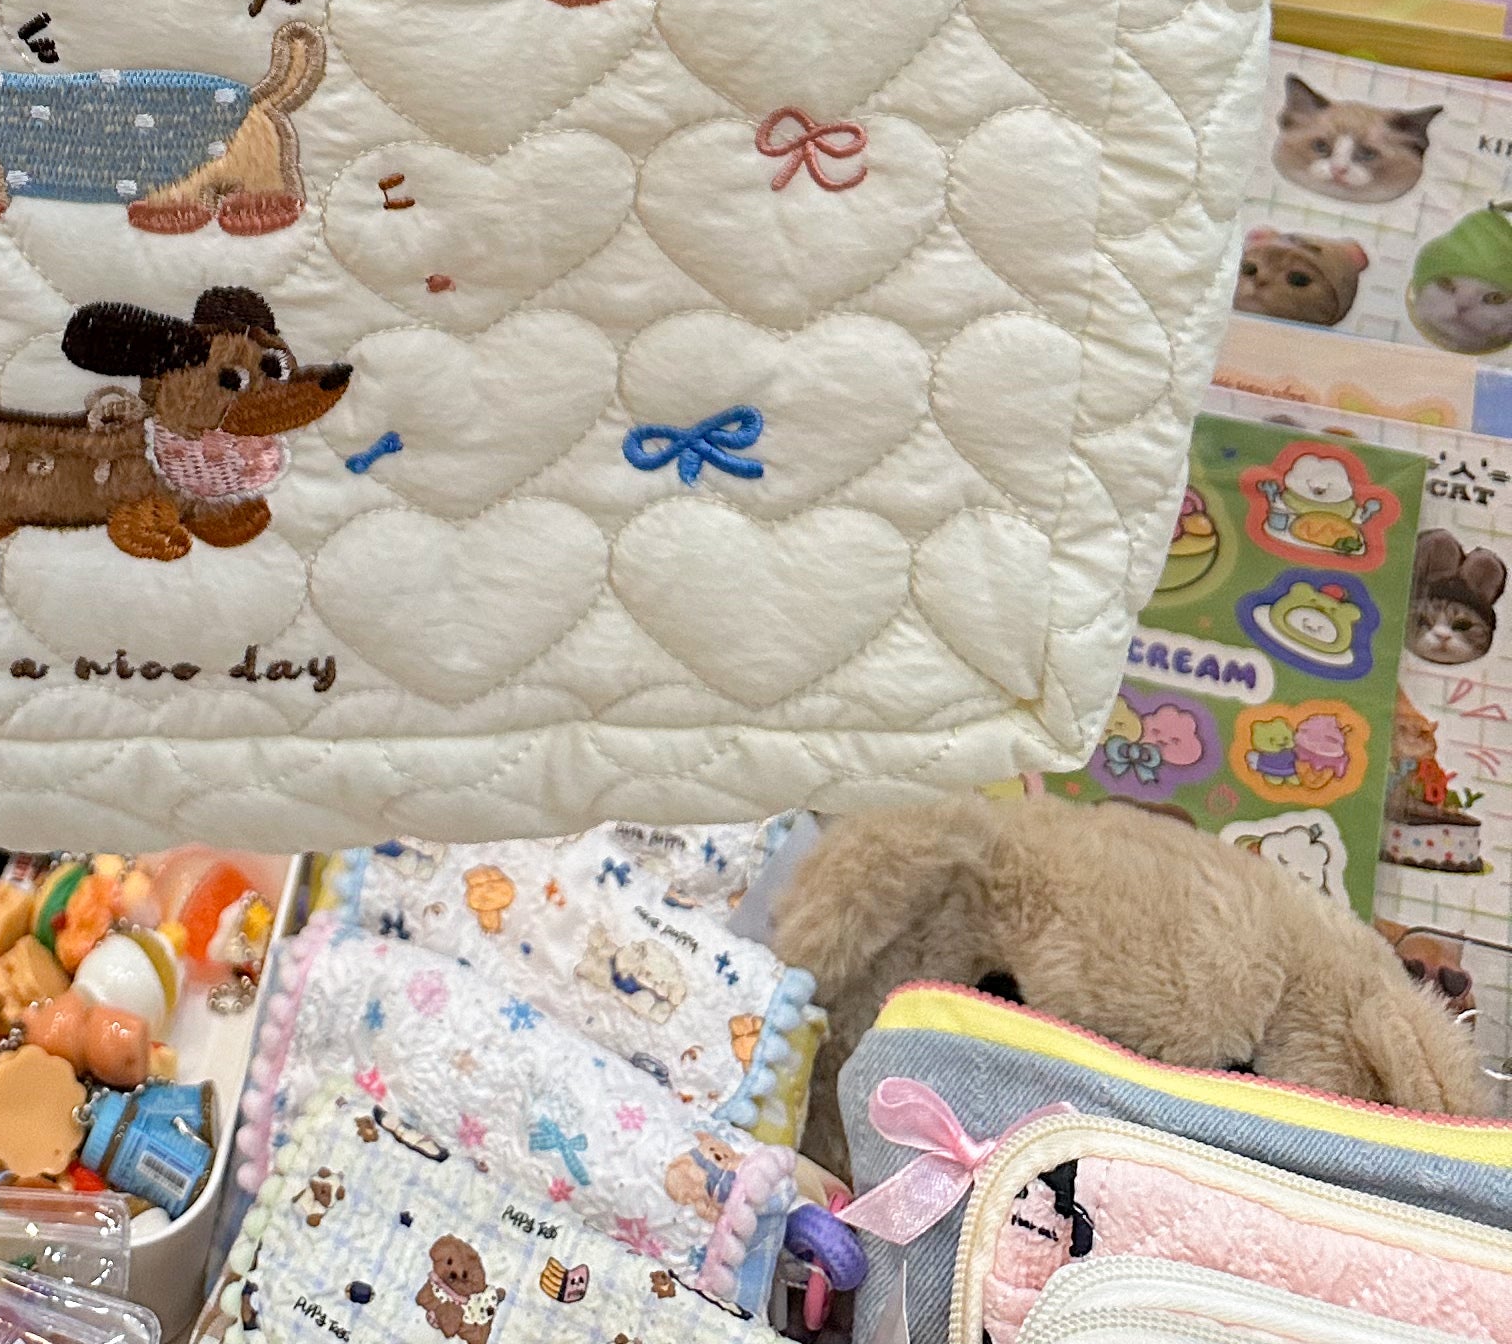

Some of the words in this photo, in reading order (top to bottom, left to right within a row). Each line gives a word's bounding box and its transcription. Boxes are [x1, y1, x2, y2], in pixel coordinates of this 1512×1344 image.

[1426, 478, 1495, 506] CAT
[10, 657, 50, 679] a
[74, 649, 201, 680] nice
[229, 644, 337, 692] day
[1127, 635, 1257, 690] CREAM
